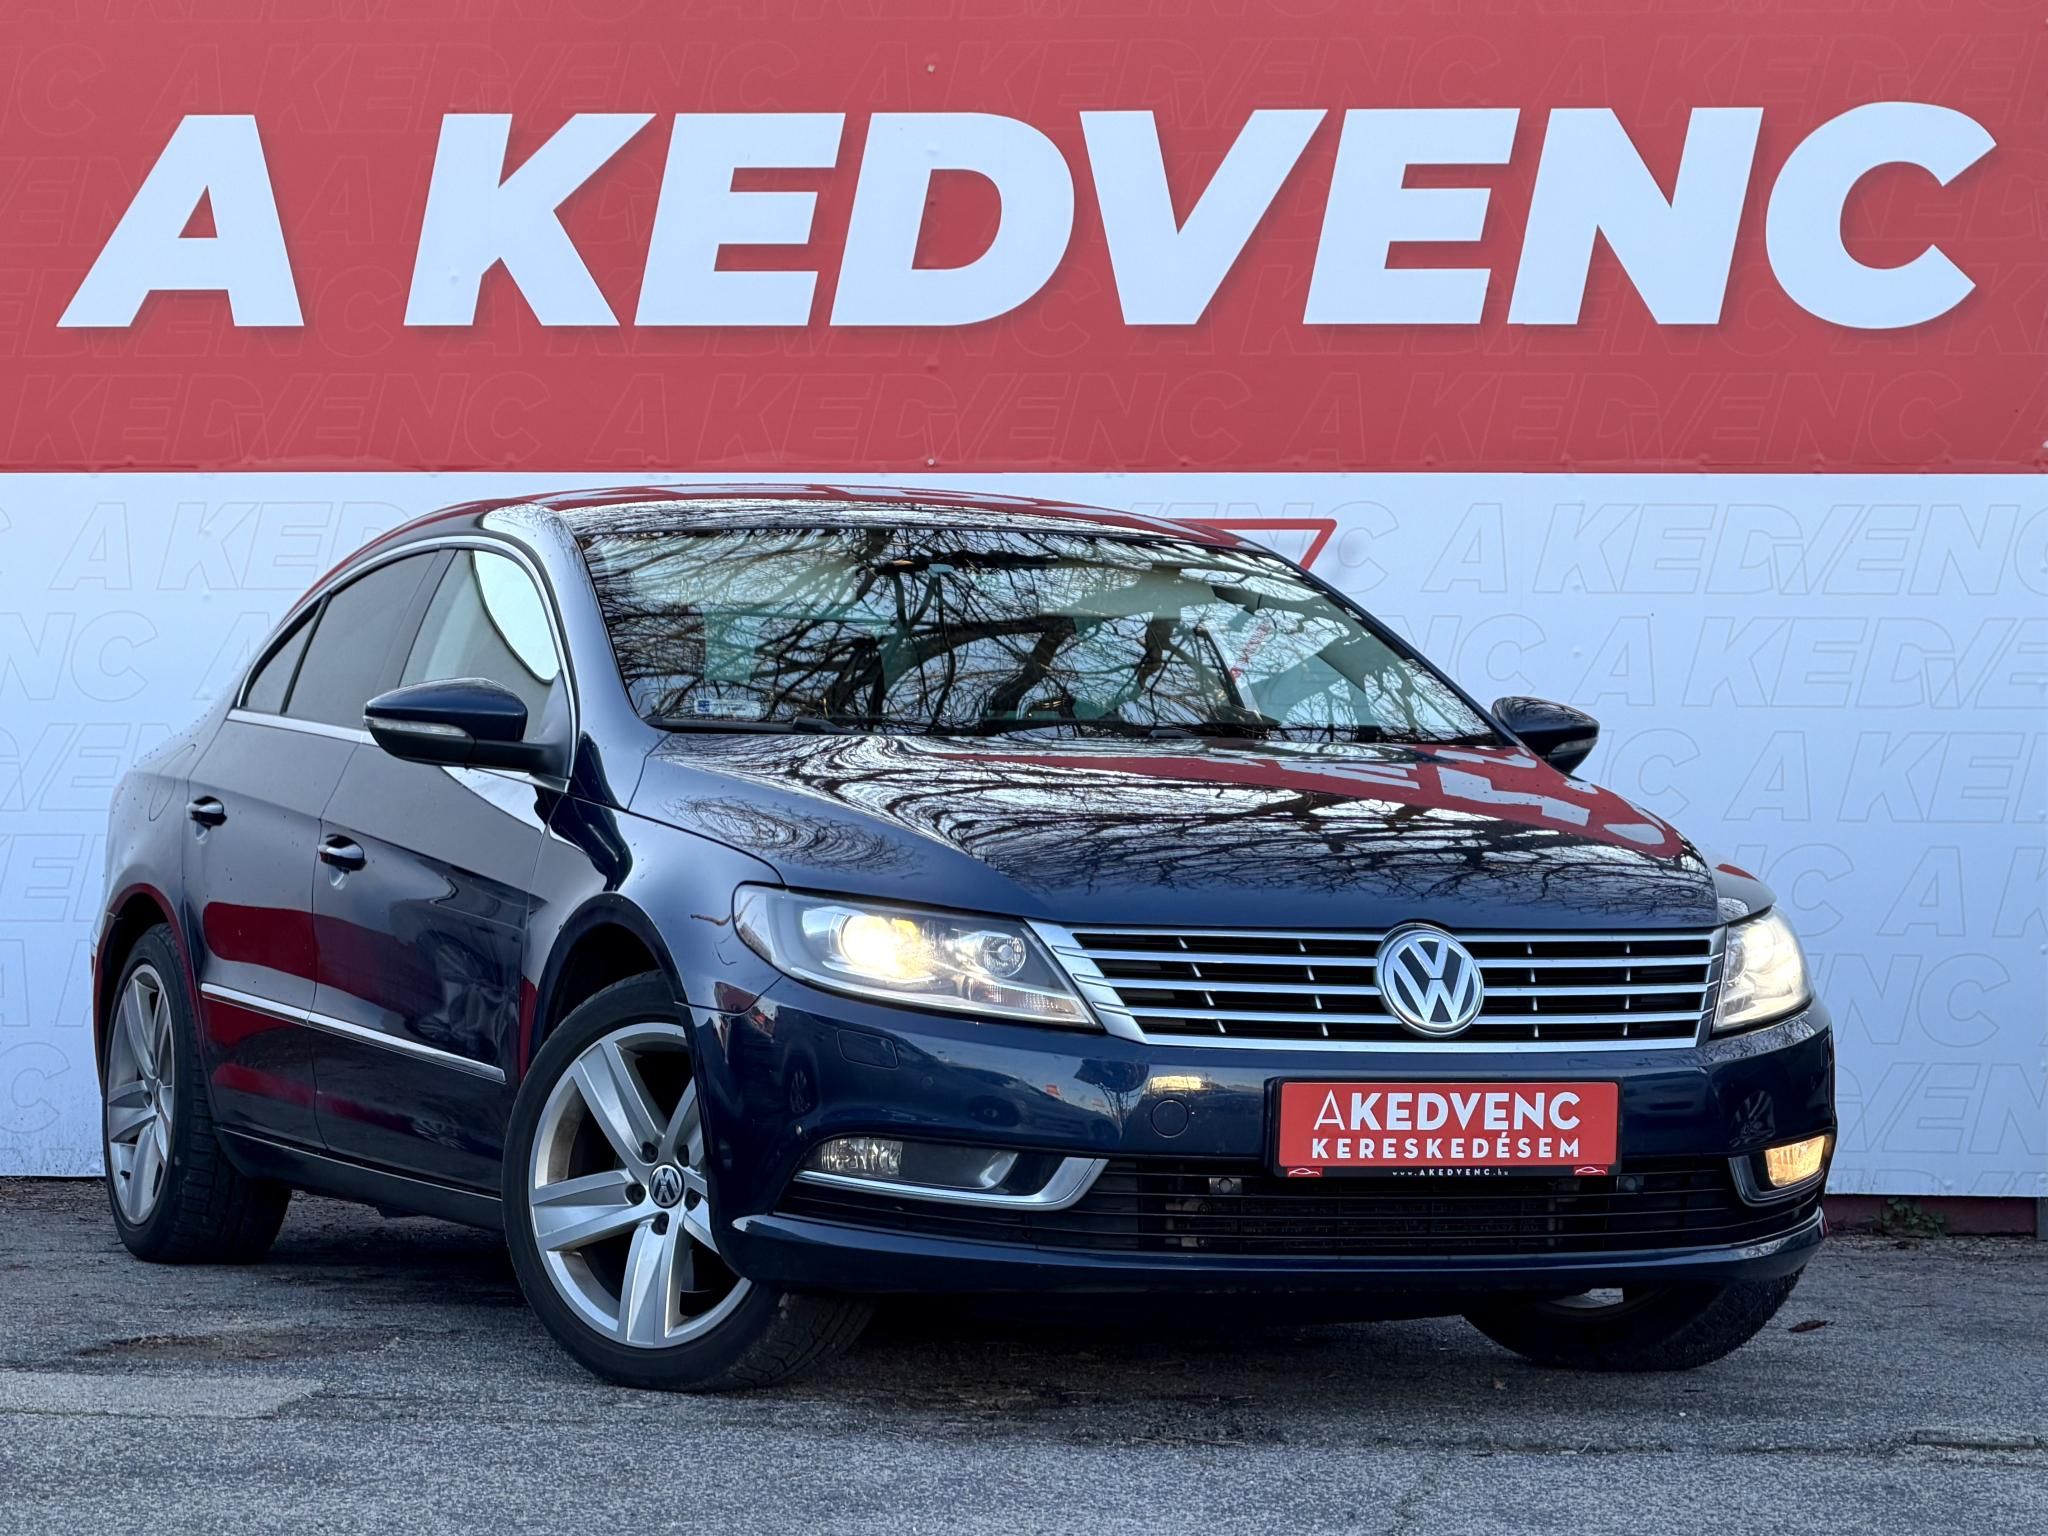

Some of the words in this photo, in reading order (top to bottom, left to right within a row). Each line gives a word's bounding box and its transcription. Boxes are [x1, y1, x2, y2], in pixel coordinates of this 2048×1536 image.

[57, 113, 305, 329] A
[403, 100, 1998, 330] KEDVENC
[1311, 1132, 1580, 1160] KERESKEDÉSEM
